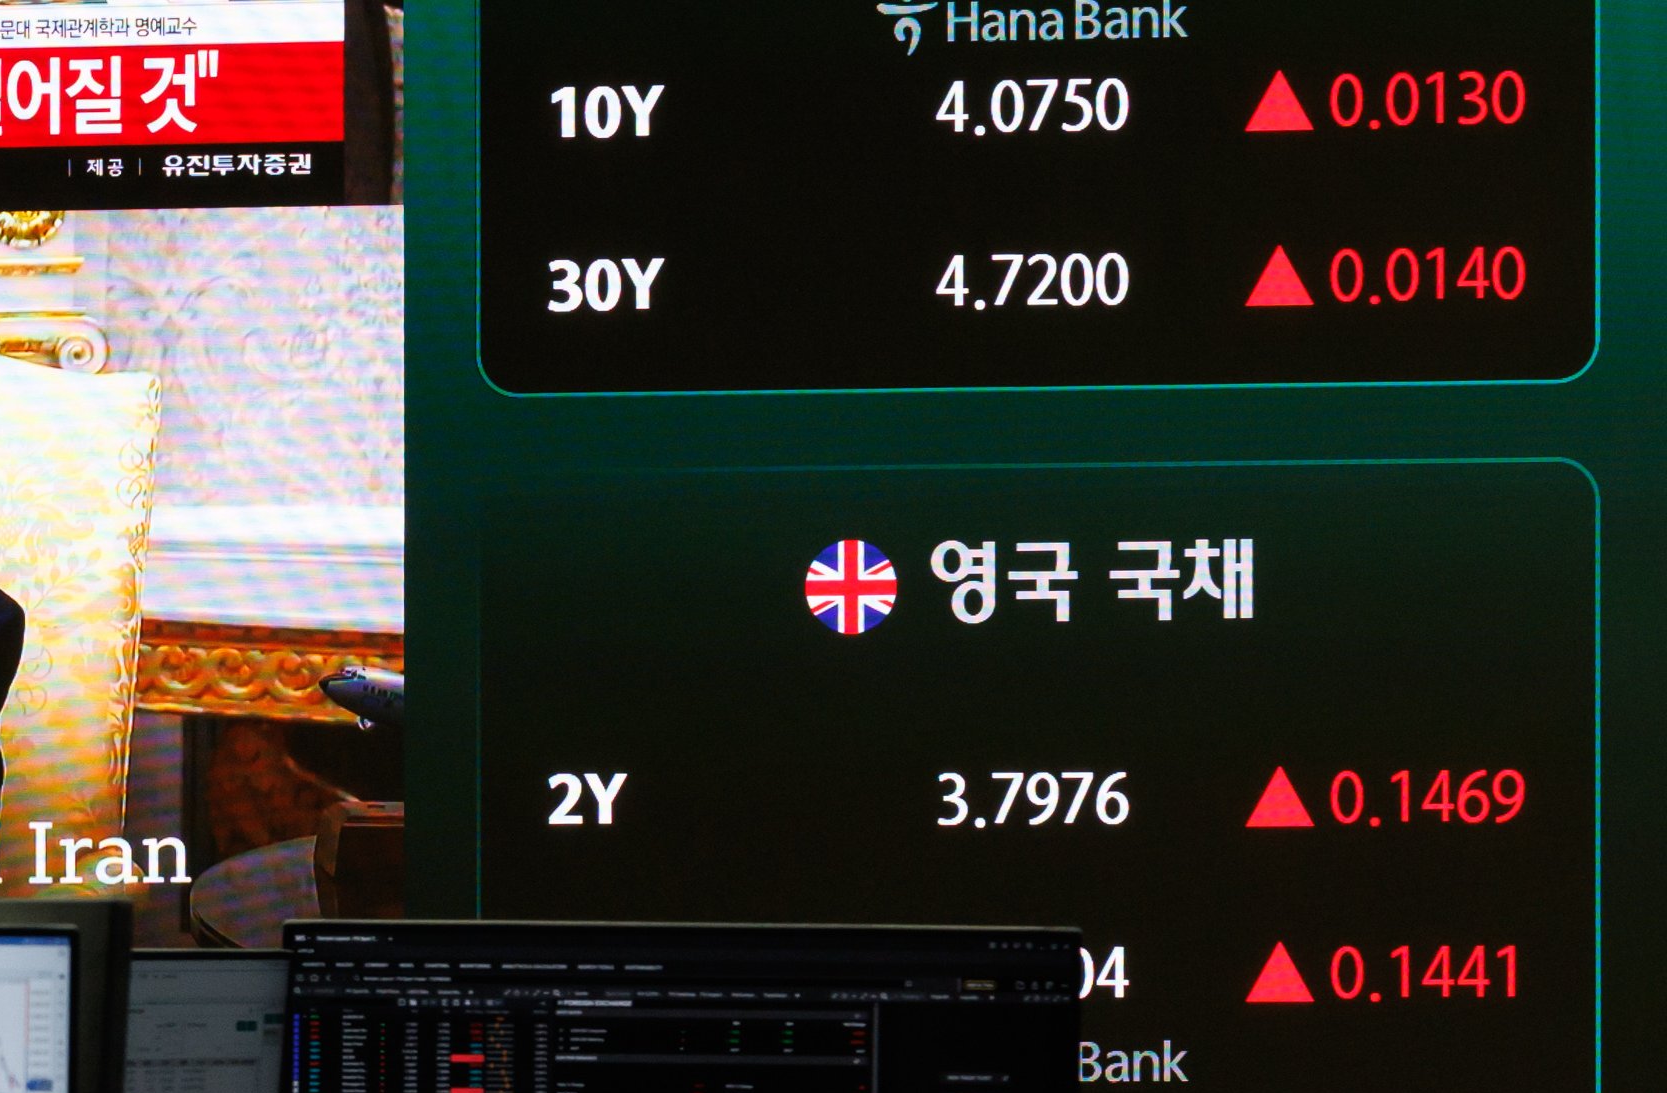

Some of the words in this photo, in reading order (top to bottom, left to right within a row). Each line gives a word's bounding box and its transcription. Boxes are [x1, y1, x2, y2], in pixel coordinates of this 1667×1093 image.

[35, 18, 130, 39] 국제관계학과
[135, 16, 198, 37] 명예교수
[947, 1, 1065, 42] Hana
[1075, 0, 1188, 40] Bank
[141, 49, 220, 134] 것"
[549, 85, 665, 139] 10Y
[935, 78, 1130, 136] 4.0750
[1328, 70, 1527, 131] 0.0130
[86, 157, 124, 177] 제공
[161, 153, 312, 177] 유진투자증권
[547, 256, 665, 313] 30Y
[935, 252, 1130, 312] 4.7200
[1328, 246, 1527, 305] 0.0140
[930, 539, 1079, 624] 영국
[1108, 537, 1256, 622] 국채
[547, 773, 627, 825] 2Y
[935, 772, 1131, 829] 3.7976
[1328, 768, 1527, 829] 0.1469
[28, 819, 193, 887] Iran
[1328, 944, 1520, 1004] 0.1441
[1079, 1040, 1189, 1083] Bank
